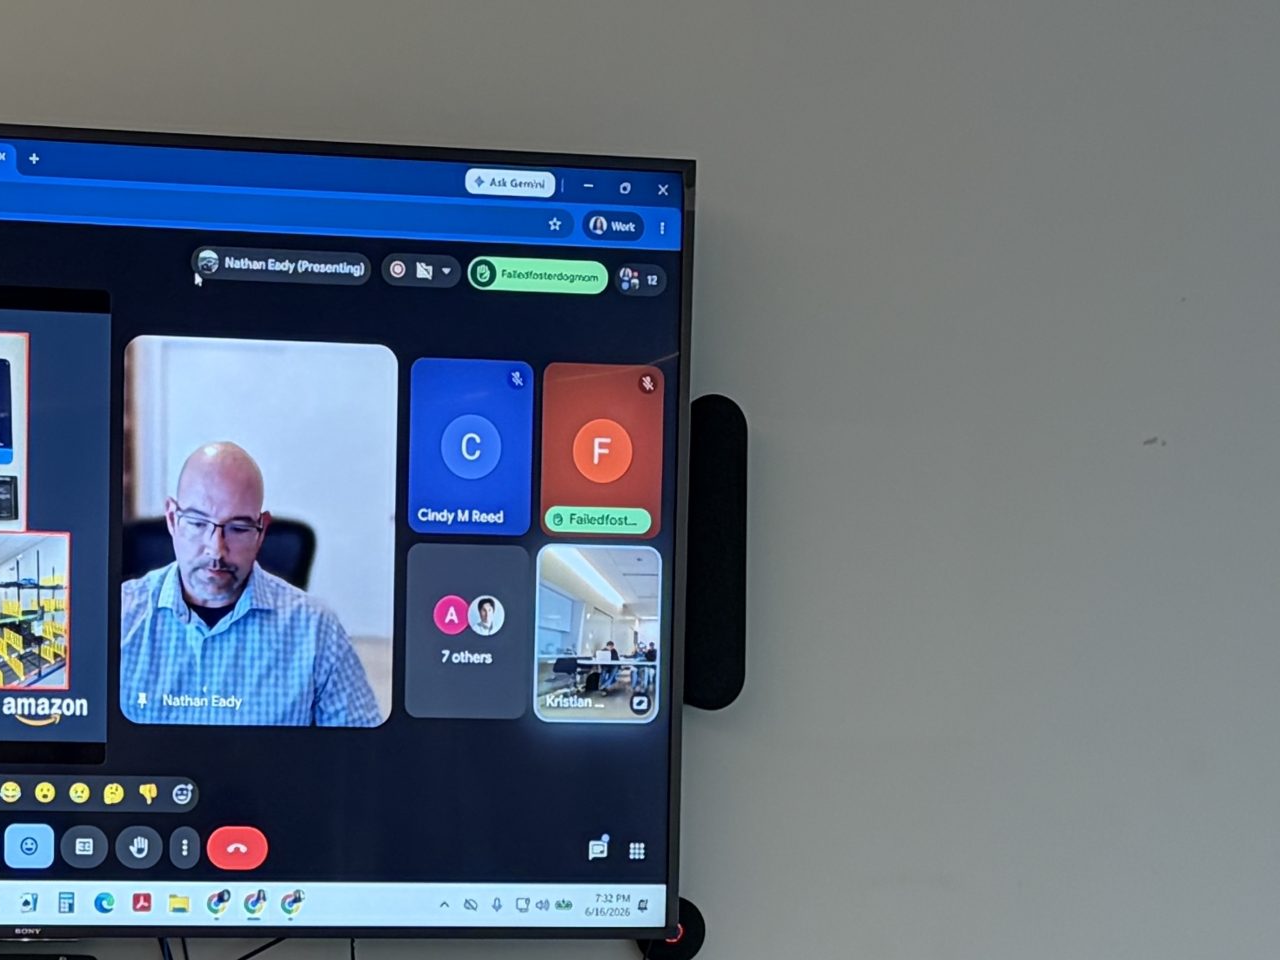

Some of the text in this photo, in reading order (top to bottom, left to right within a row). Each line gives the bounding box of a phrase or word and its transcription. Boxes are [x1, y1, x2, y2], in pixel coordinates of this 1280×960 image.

[489, 177, 545, 190] Ask Gemini
[610, 221, 636, 232] Work
[224, 256, 365, 277] Nathan Eady (Presenting)
[646, 274, 658, 286] 12
[461, 432, 482, 460] C
[592, 437, 612, 465] F
[417, 508, 504, 525] Cindy M Reed
[444, 606, 459, 624] A
[441, 649, 493, 664] 7 others
[2, 696, 88, 716] amazon
[162, 694, 243, 710] Nathan Eady
[546, 695, 592, 708] Kristian
[595, 893, 631, 903] 7:32 PM
[584, 907, 631, 917] 6/16/2026
